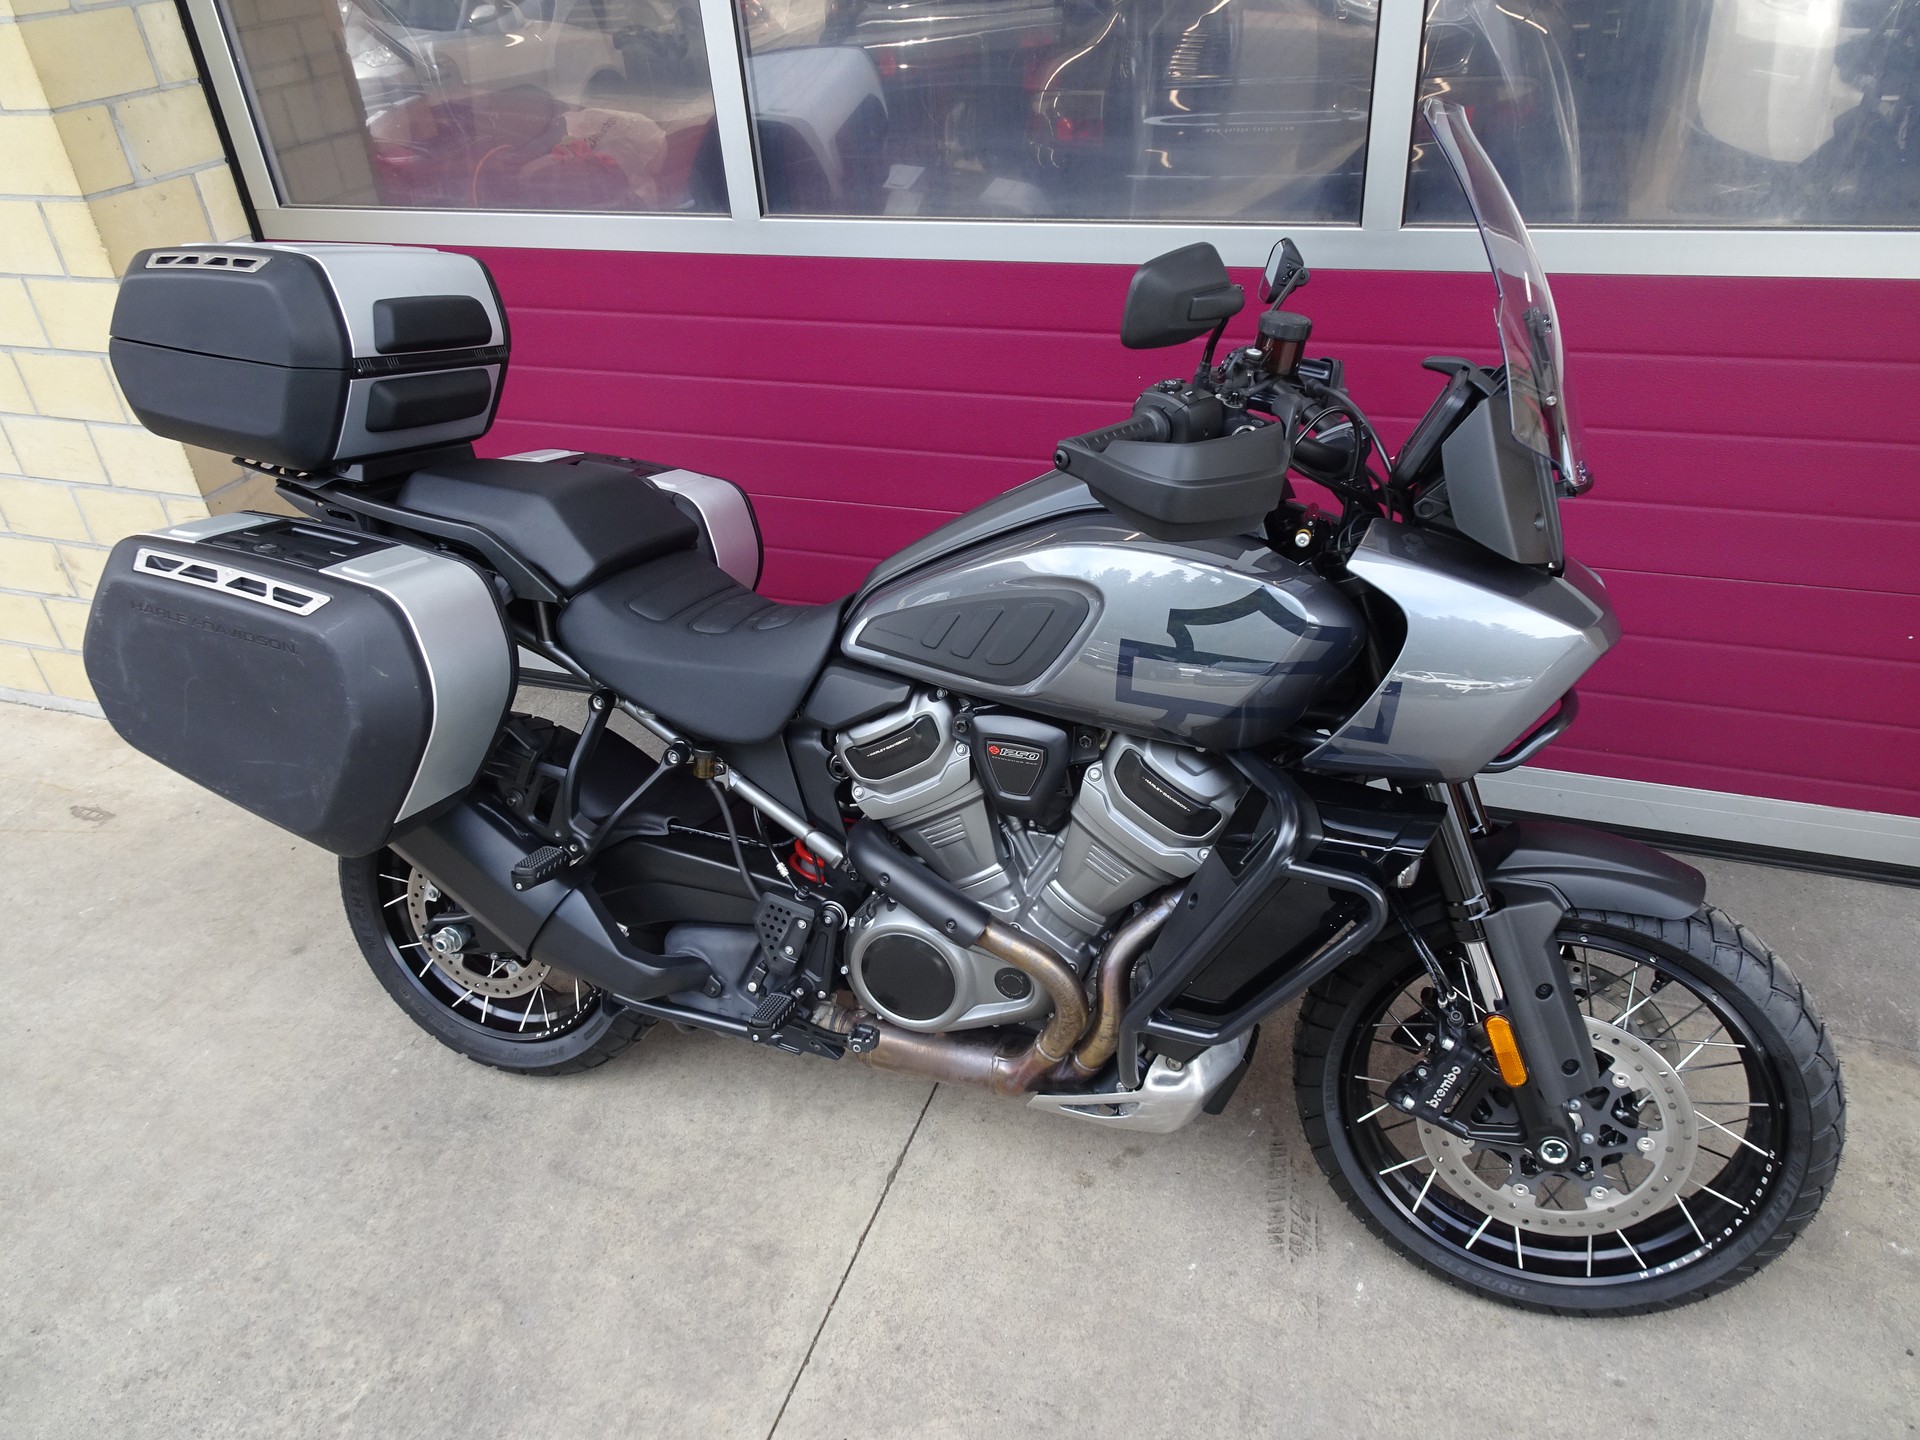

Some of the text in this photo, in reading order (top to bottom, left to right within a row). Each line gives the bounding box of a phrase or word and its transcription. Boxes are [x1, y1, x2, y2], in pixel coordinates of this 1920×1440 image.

[131, 600, 299, 655] HARLEY-DAVIDSON
[1000, 747, 1040, 760] 1250
[1425, 1066, 1462, 1109] brembo
[1639, 1149, 1776, 1279] HARLEY-DAVIDSON
